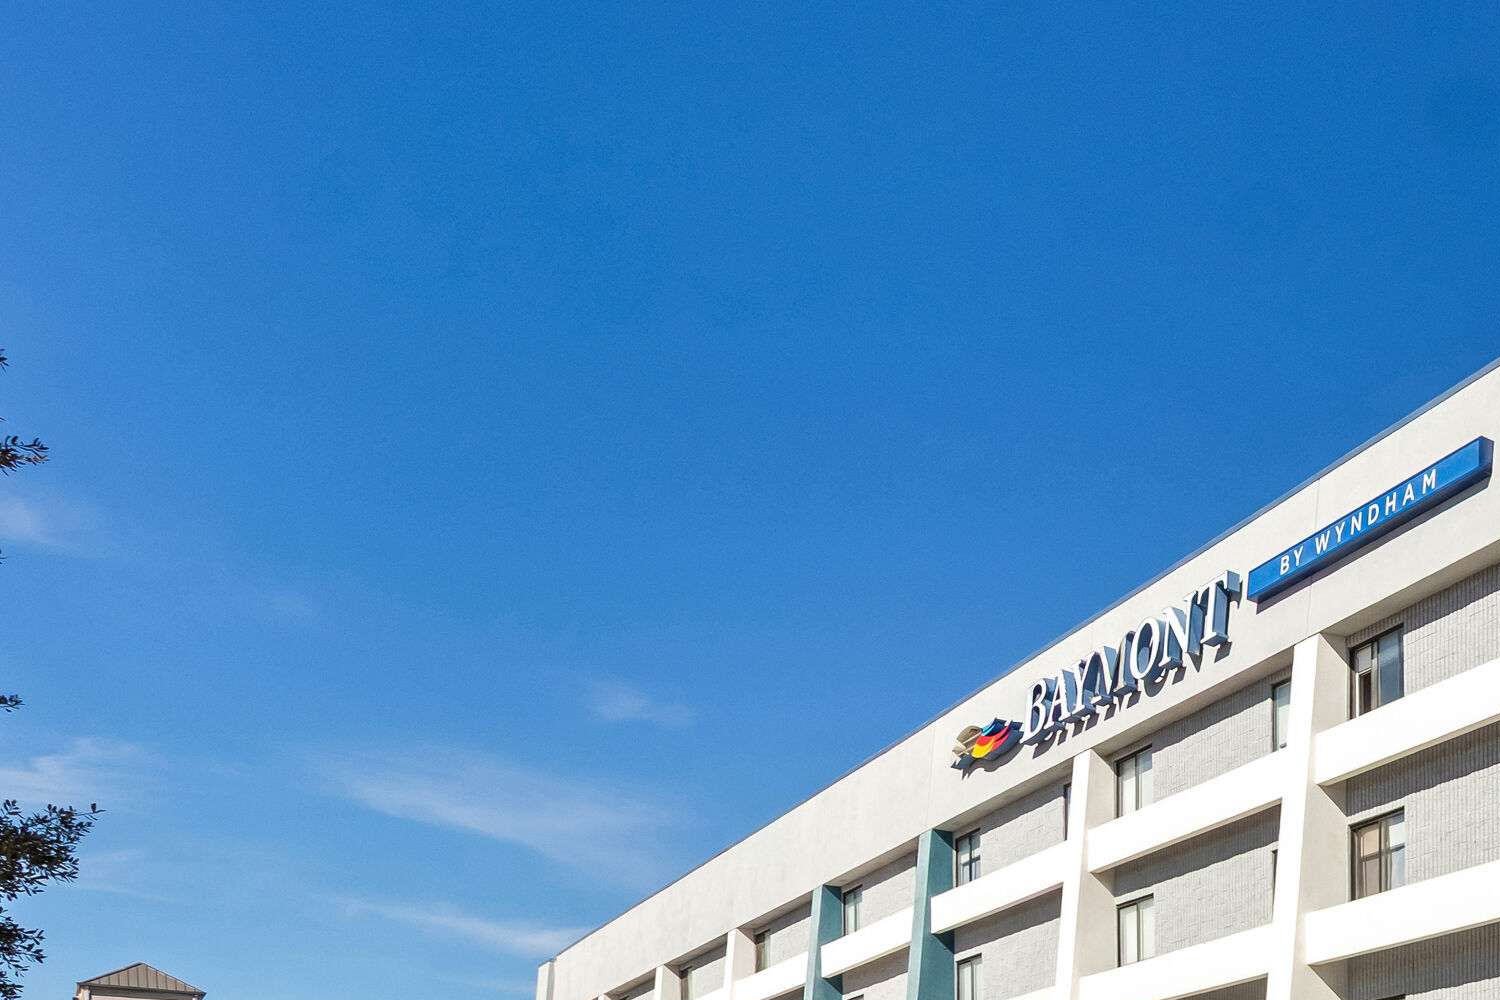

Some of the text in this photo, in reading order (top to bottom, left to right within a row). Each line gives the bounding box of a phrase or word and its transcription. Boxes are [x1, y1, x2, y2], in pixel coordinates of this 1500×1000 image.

[1279, 468, 1438, 576] BY WYNDHAM
[1019, 570, 1241, 746] BAYMONT
